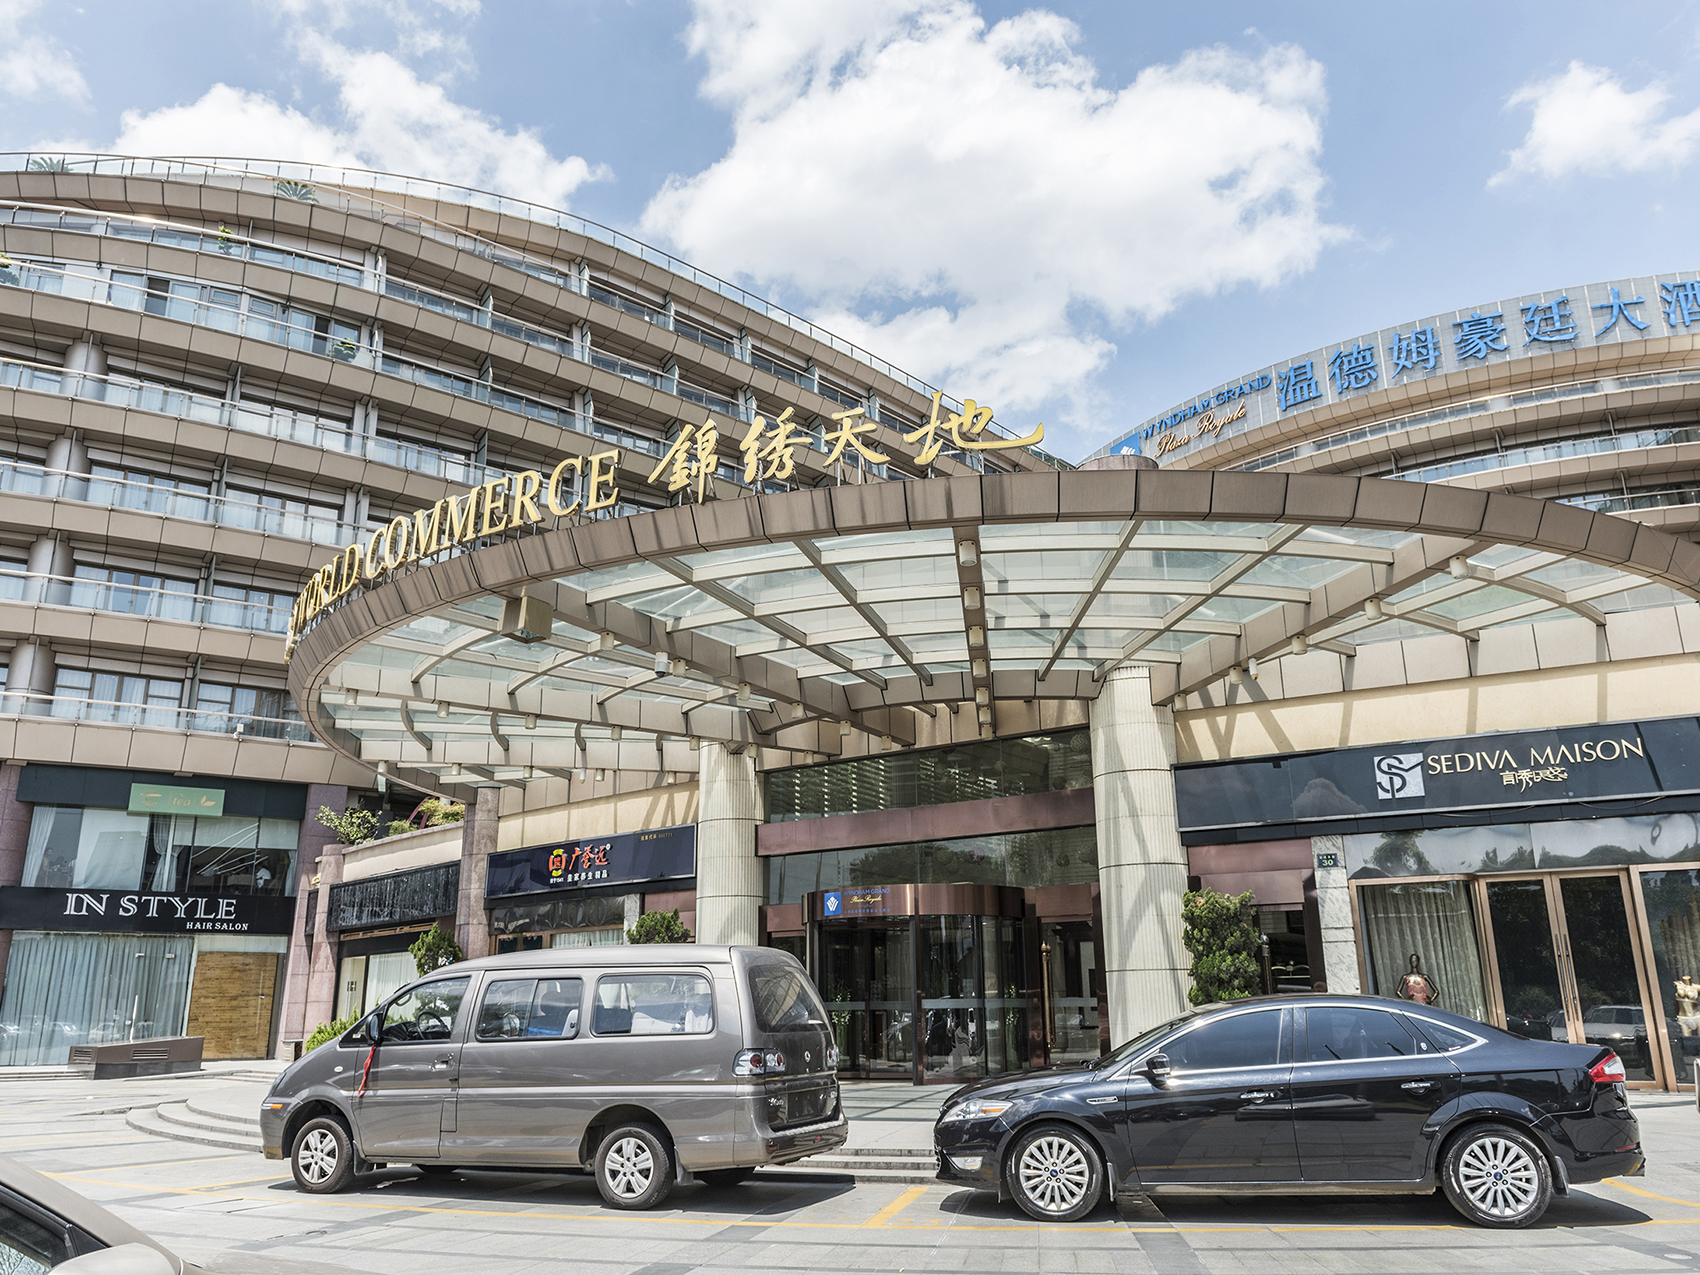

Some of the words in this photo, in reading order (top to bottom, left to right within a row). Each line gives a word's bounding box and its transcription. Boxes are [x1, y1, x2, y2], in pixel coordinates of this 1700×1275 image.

[1276, 281, 1700, 411] 温德姆豪廷大酒
[1141, 396, 1212, 440] WYNDHAM
[1215, 374, 1271, 405] GRAND
[1153, 432, 1190, 458] Plaza
[1192, 401, 1247, 438] Royale
[366, 448, 622, 579] COMMERCE
[1427, 750, 1517, 775] SEDIVA
[1530, 738, 1644, 766] MAISON
[63, 892, 110, 916] IN
[118, 895, 236, 920] STYLE
[186, 921, 213, 930] HAIR
[215, 922, 249, 931] SALON
